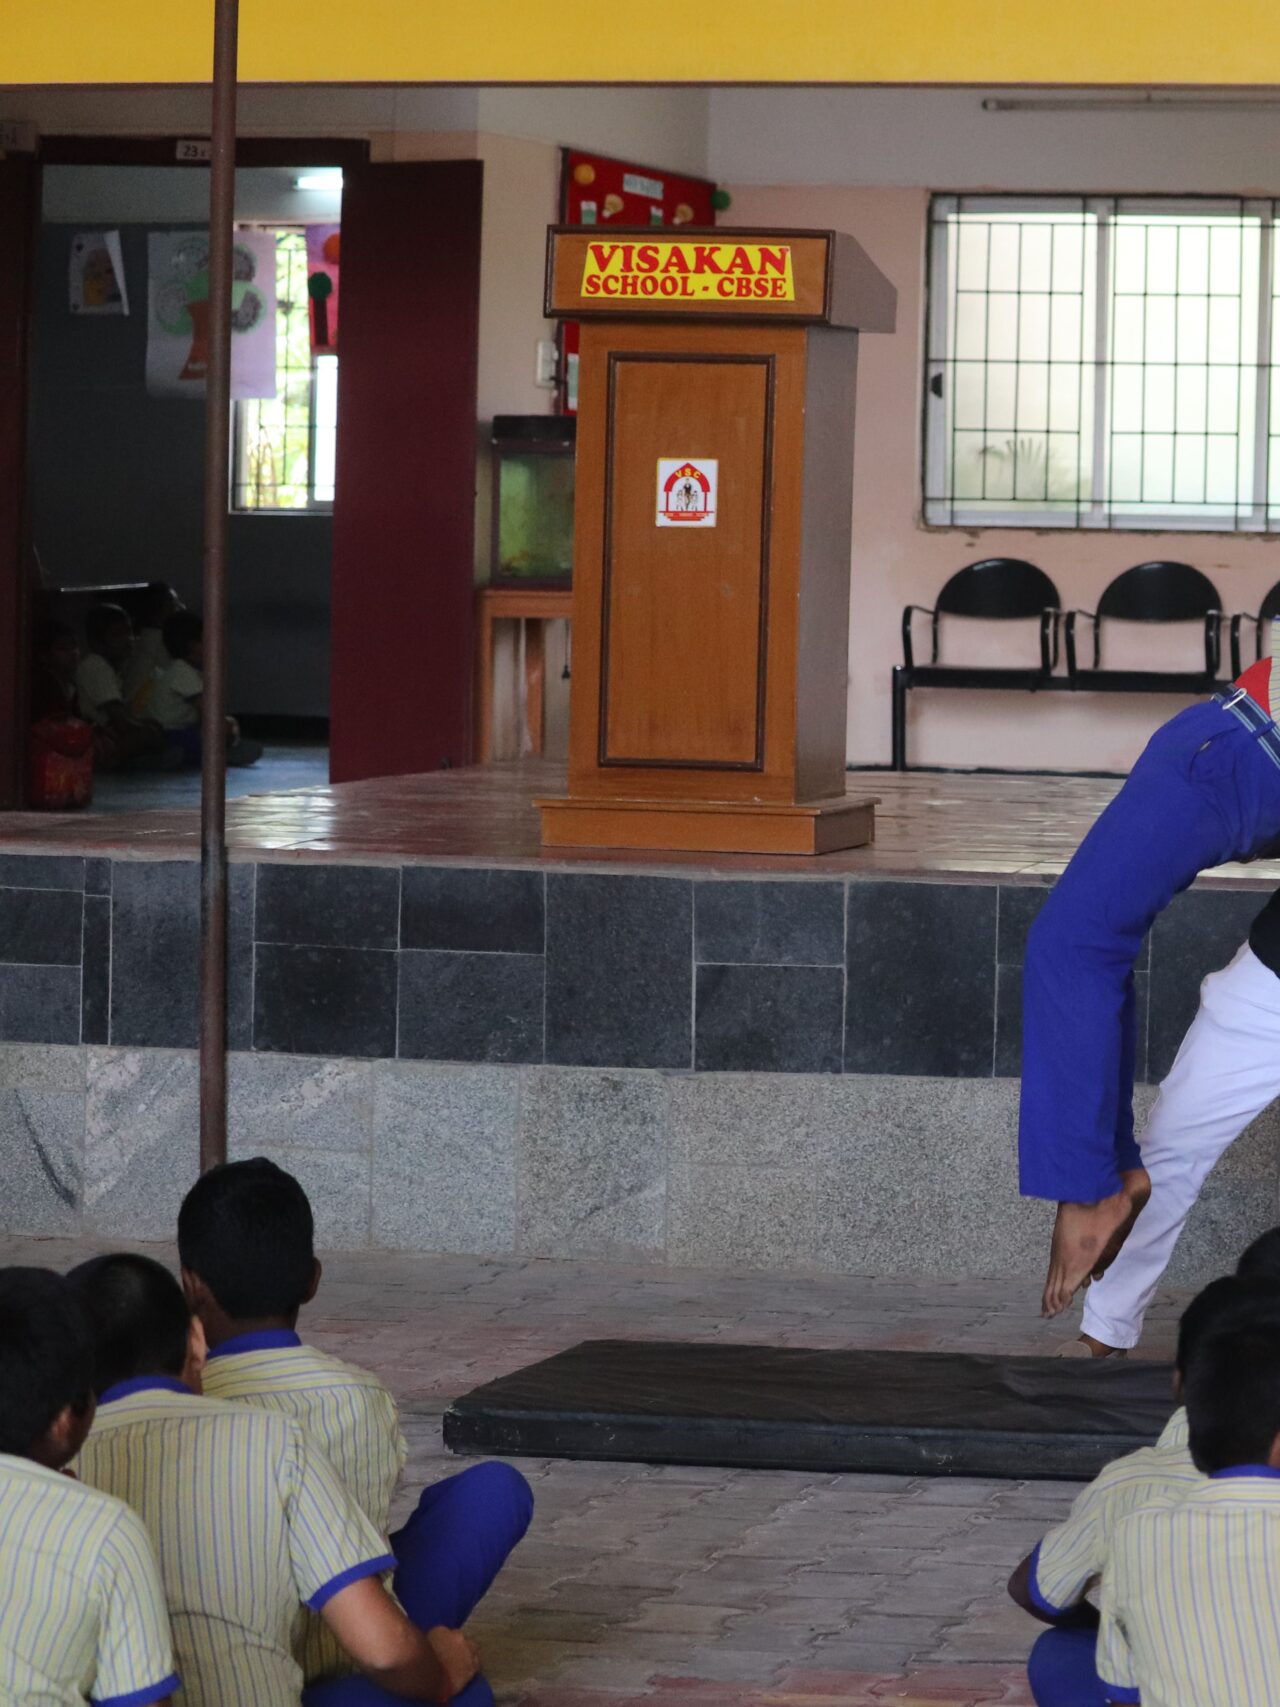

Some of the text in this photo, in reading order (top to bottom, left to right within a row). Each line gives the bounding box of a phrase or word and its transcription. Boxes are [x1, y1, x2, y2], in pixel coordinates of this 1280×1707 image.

[589, 244, 790, 275] VISAKAN
[584, 274, 695, 297] SCHOOL
[717, 276, 787, 298] CBSE
